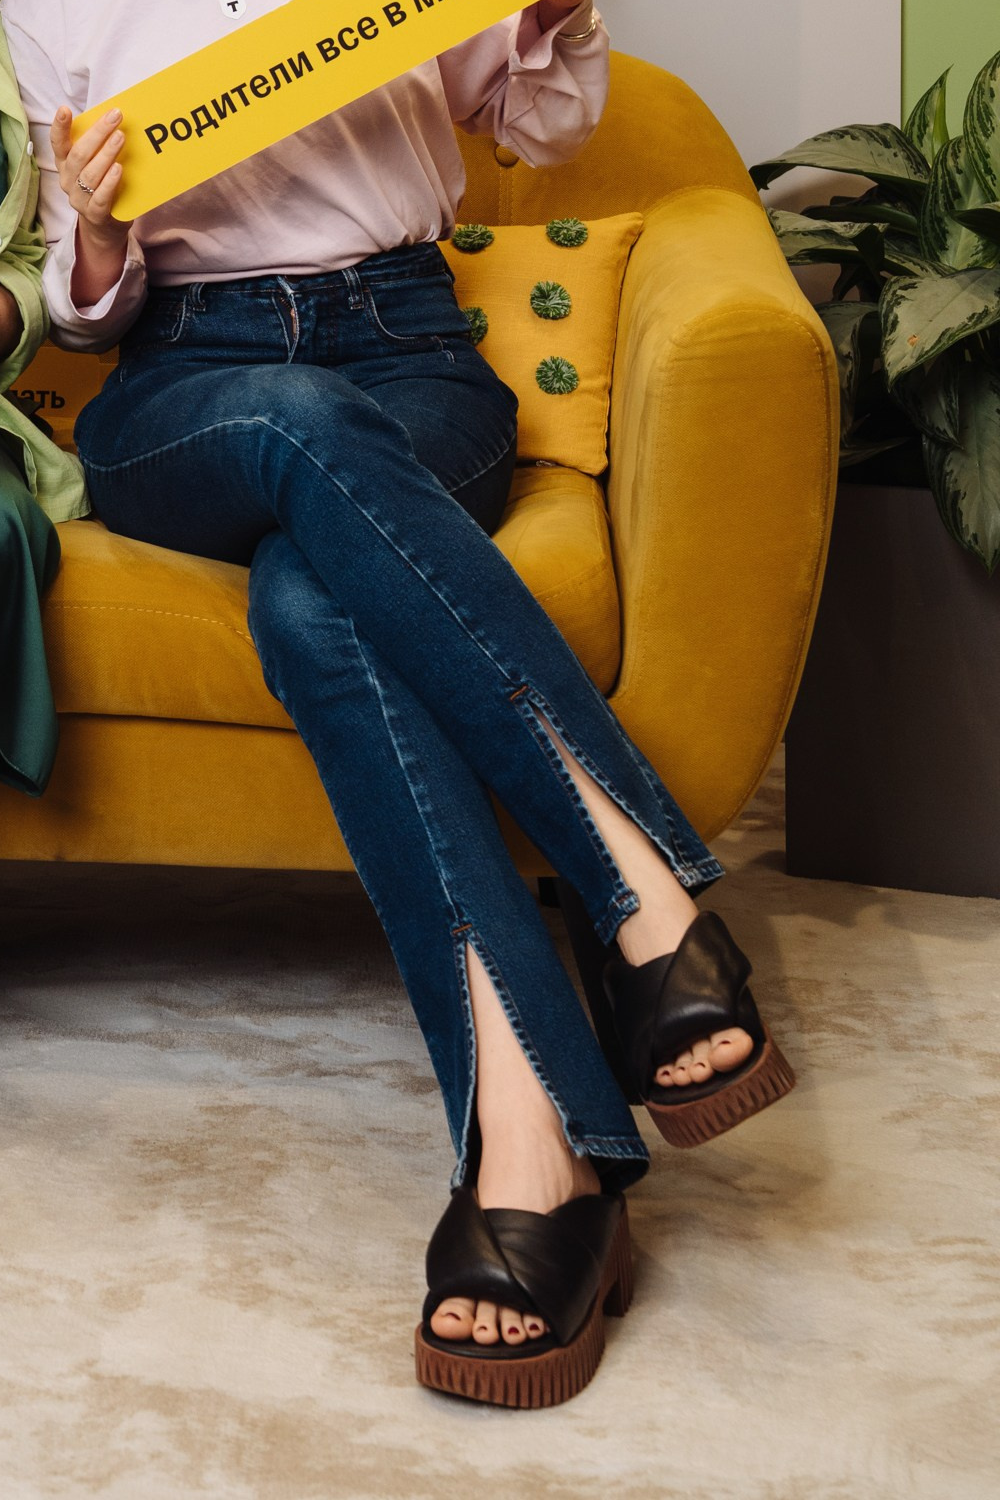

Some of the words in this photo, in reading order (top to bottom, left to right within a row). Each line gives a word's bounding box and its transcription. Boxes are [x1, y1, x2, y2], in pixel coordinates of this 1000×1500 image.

[144, 50, 314, 155] Родители
[315, 16, 379, 64] все
[382, 1, 407, 28] в
